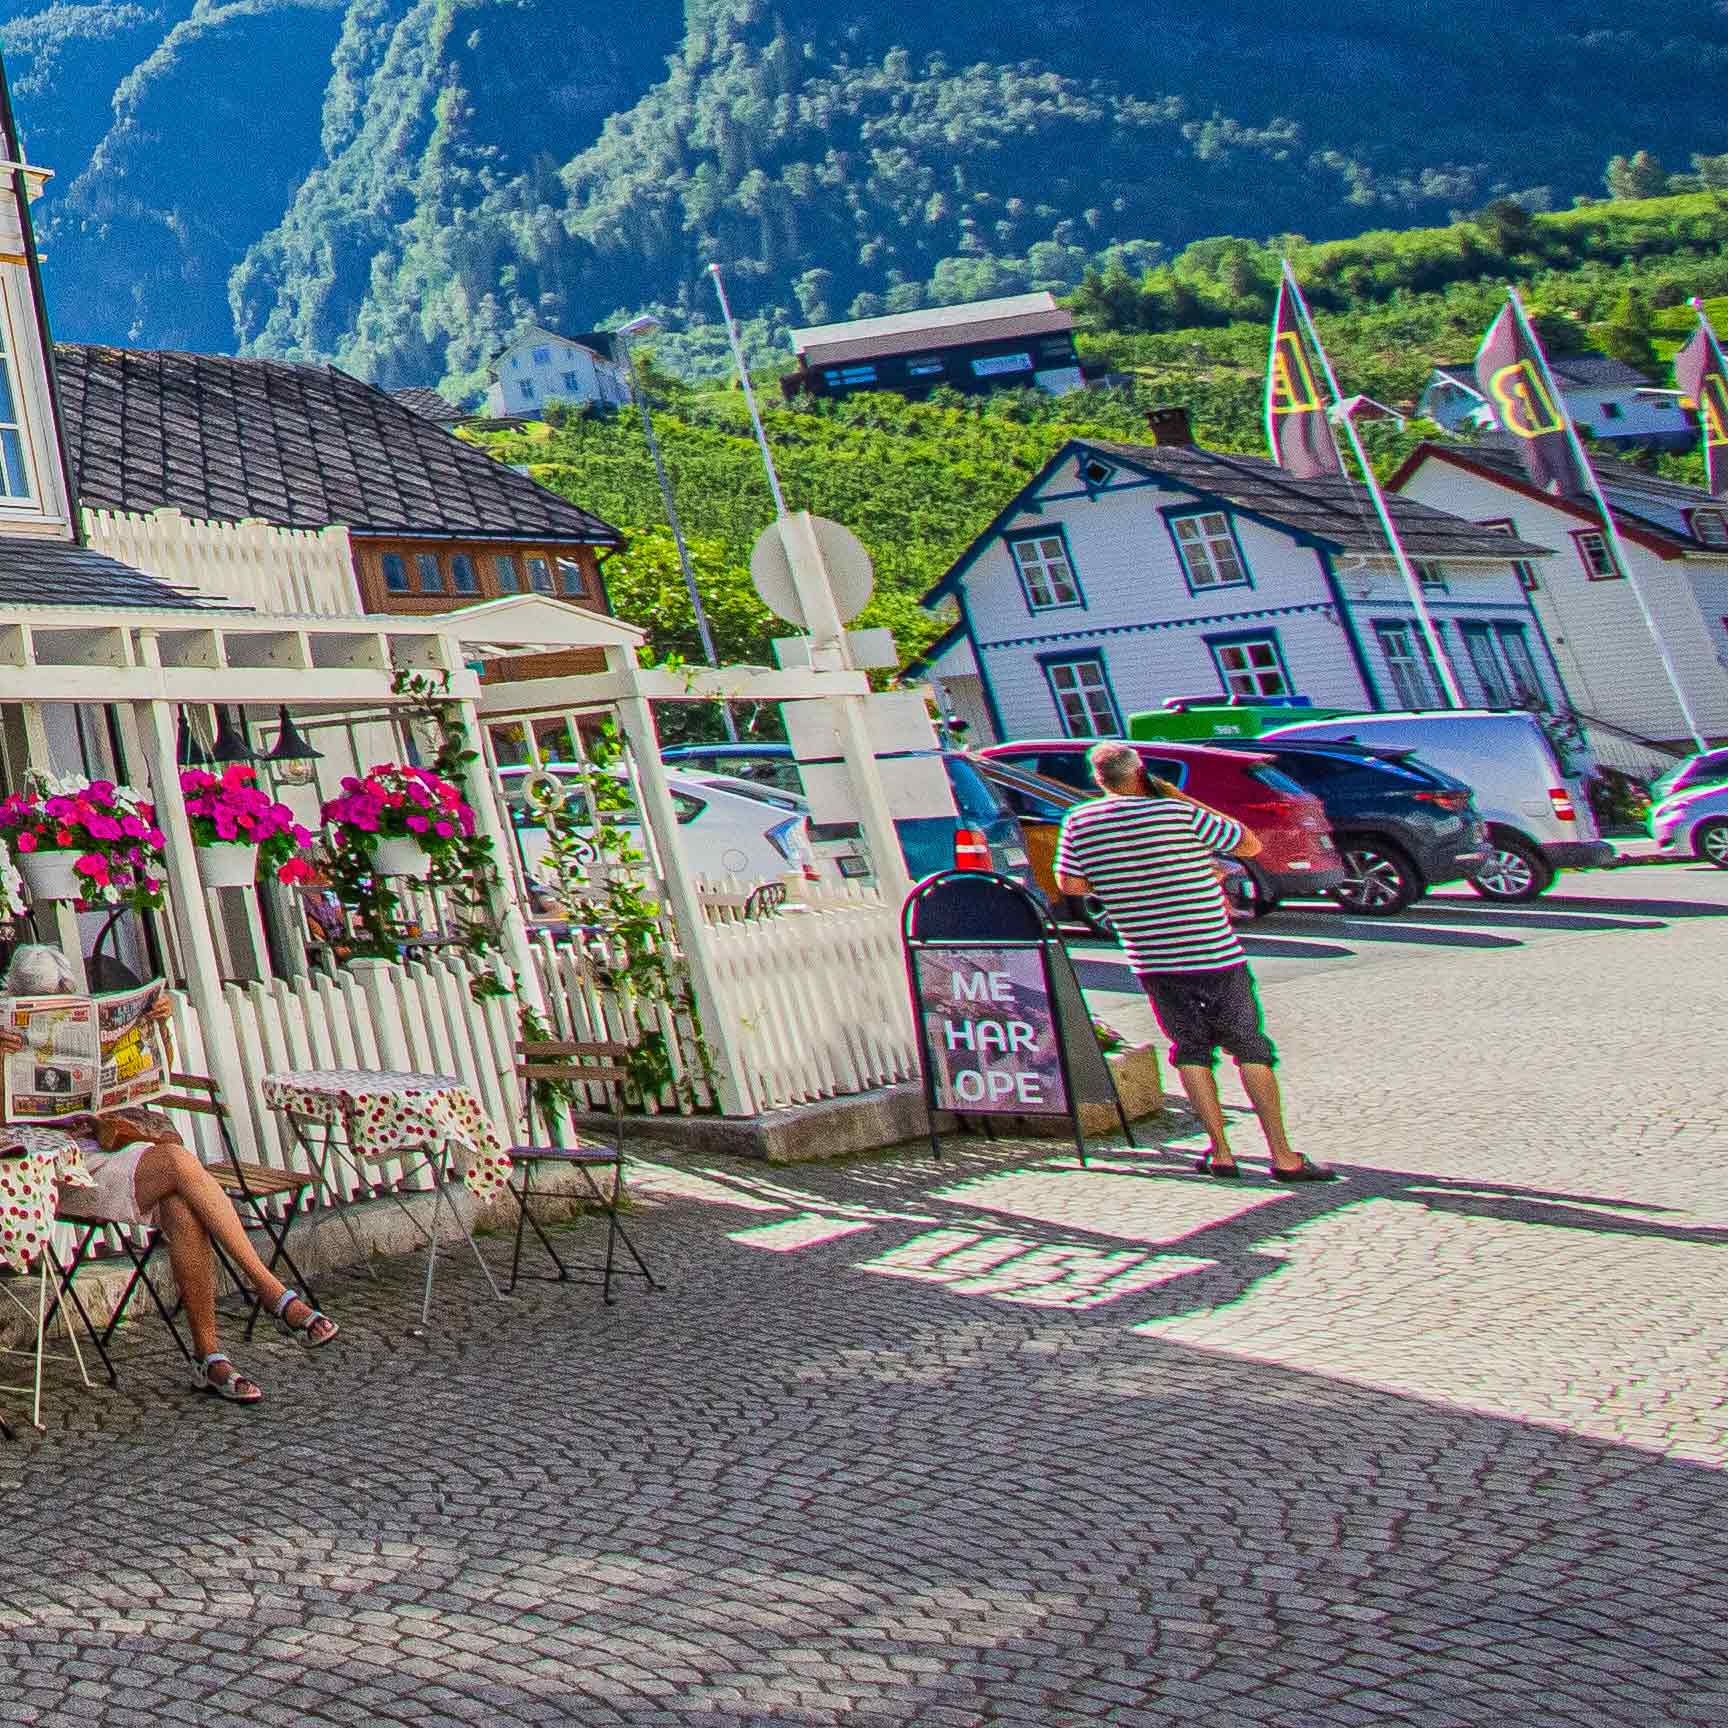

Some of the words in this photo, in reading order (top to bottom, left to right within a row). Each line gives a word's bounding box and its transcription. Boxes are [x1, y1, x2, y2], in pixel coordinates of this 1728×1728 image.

[952, 971, 1015, 1002] ME
[945, 1019, 1040, 1052] HAR
[955, 1070, 1043, 1104] OPE
